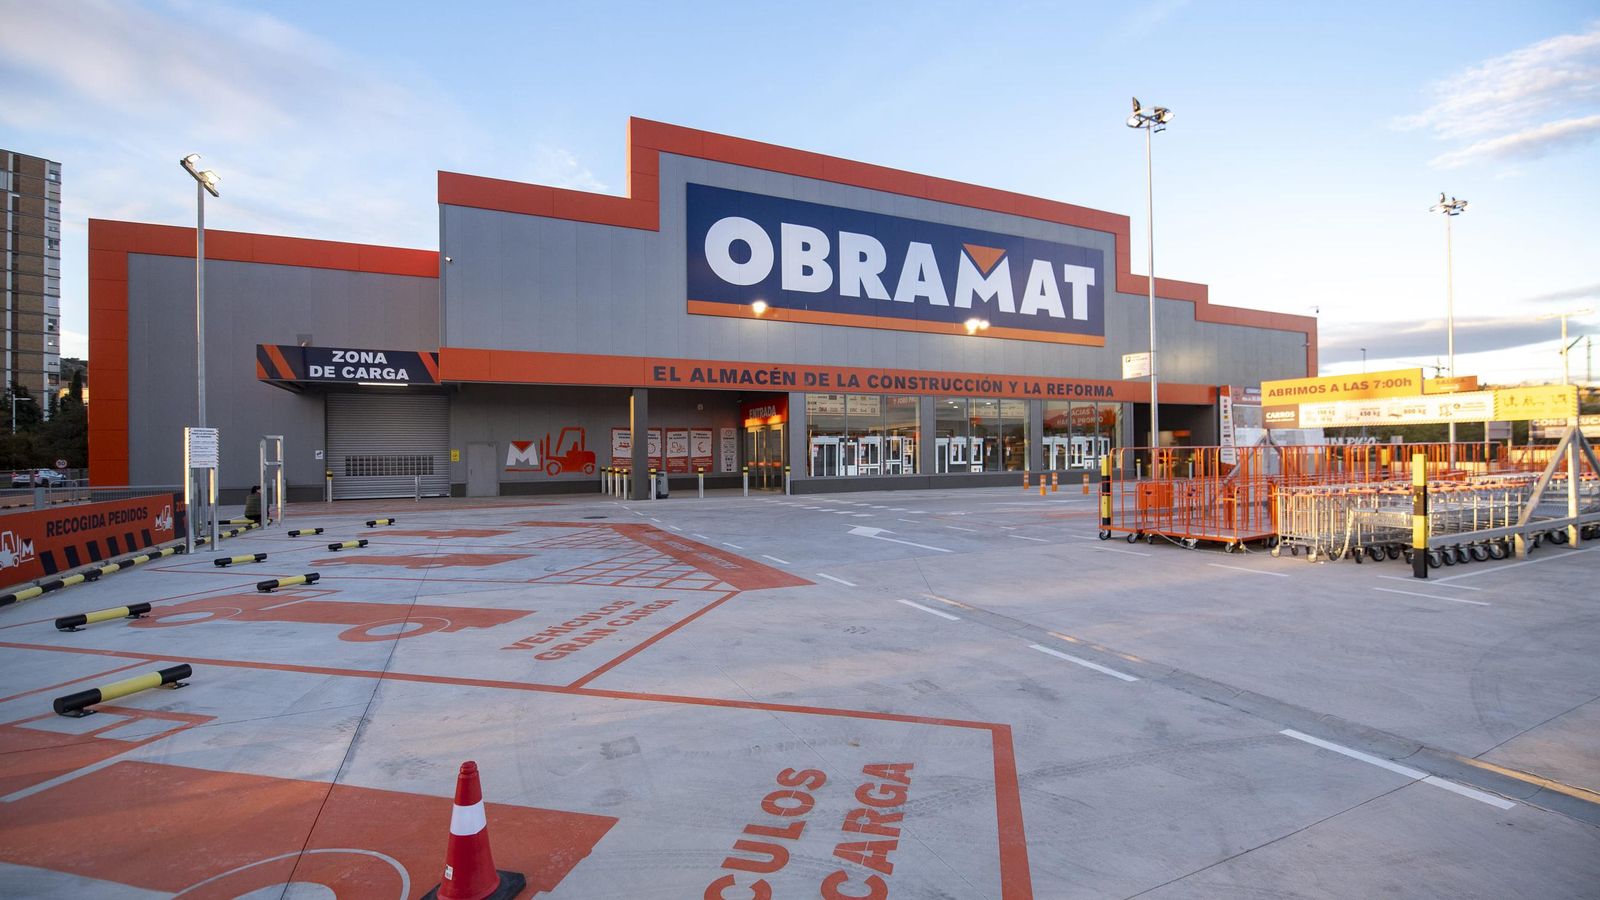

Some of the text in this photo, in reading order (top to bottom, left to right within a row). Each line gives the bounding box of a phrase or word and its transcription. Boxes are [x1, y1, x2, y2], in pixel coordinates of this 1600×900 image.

[704, 216, 1096, 321] OBRAMAT
[309, 365, 409, 380] DE CARGA
[332, 350, 387, 364] ZONA
[653, 366, 1114, 397] EL ALMACÉN DE LA CONSTRUCCIÓN Y LA REFORMA
[1268, 385, 1326, 397] ABRIMOS
[1330, 383, 1339, 392] A
[1344, 381, 1369, 392] LAS
[1374, 377, 1412, 389] 7:00h
[749, 405, 776, 418] ENTRADA
[506, 441, 539, 466] M
[46, 506, 148, 538] RECOGIDA PEDIDOS
[501, 599, 636, 650] VEHÍCULOS
[534, 599, 680, 660] GRAN CARGA
[820, 762, 914, 900] CARGA
